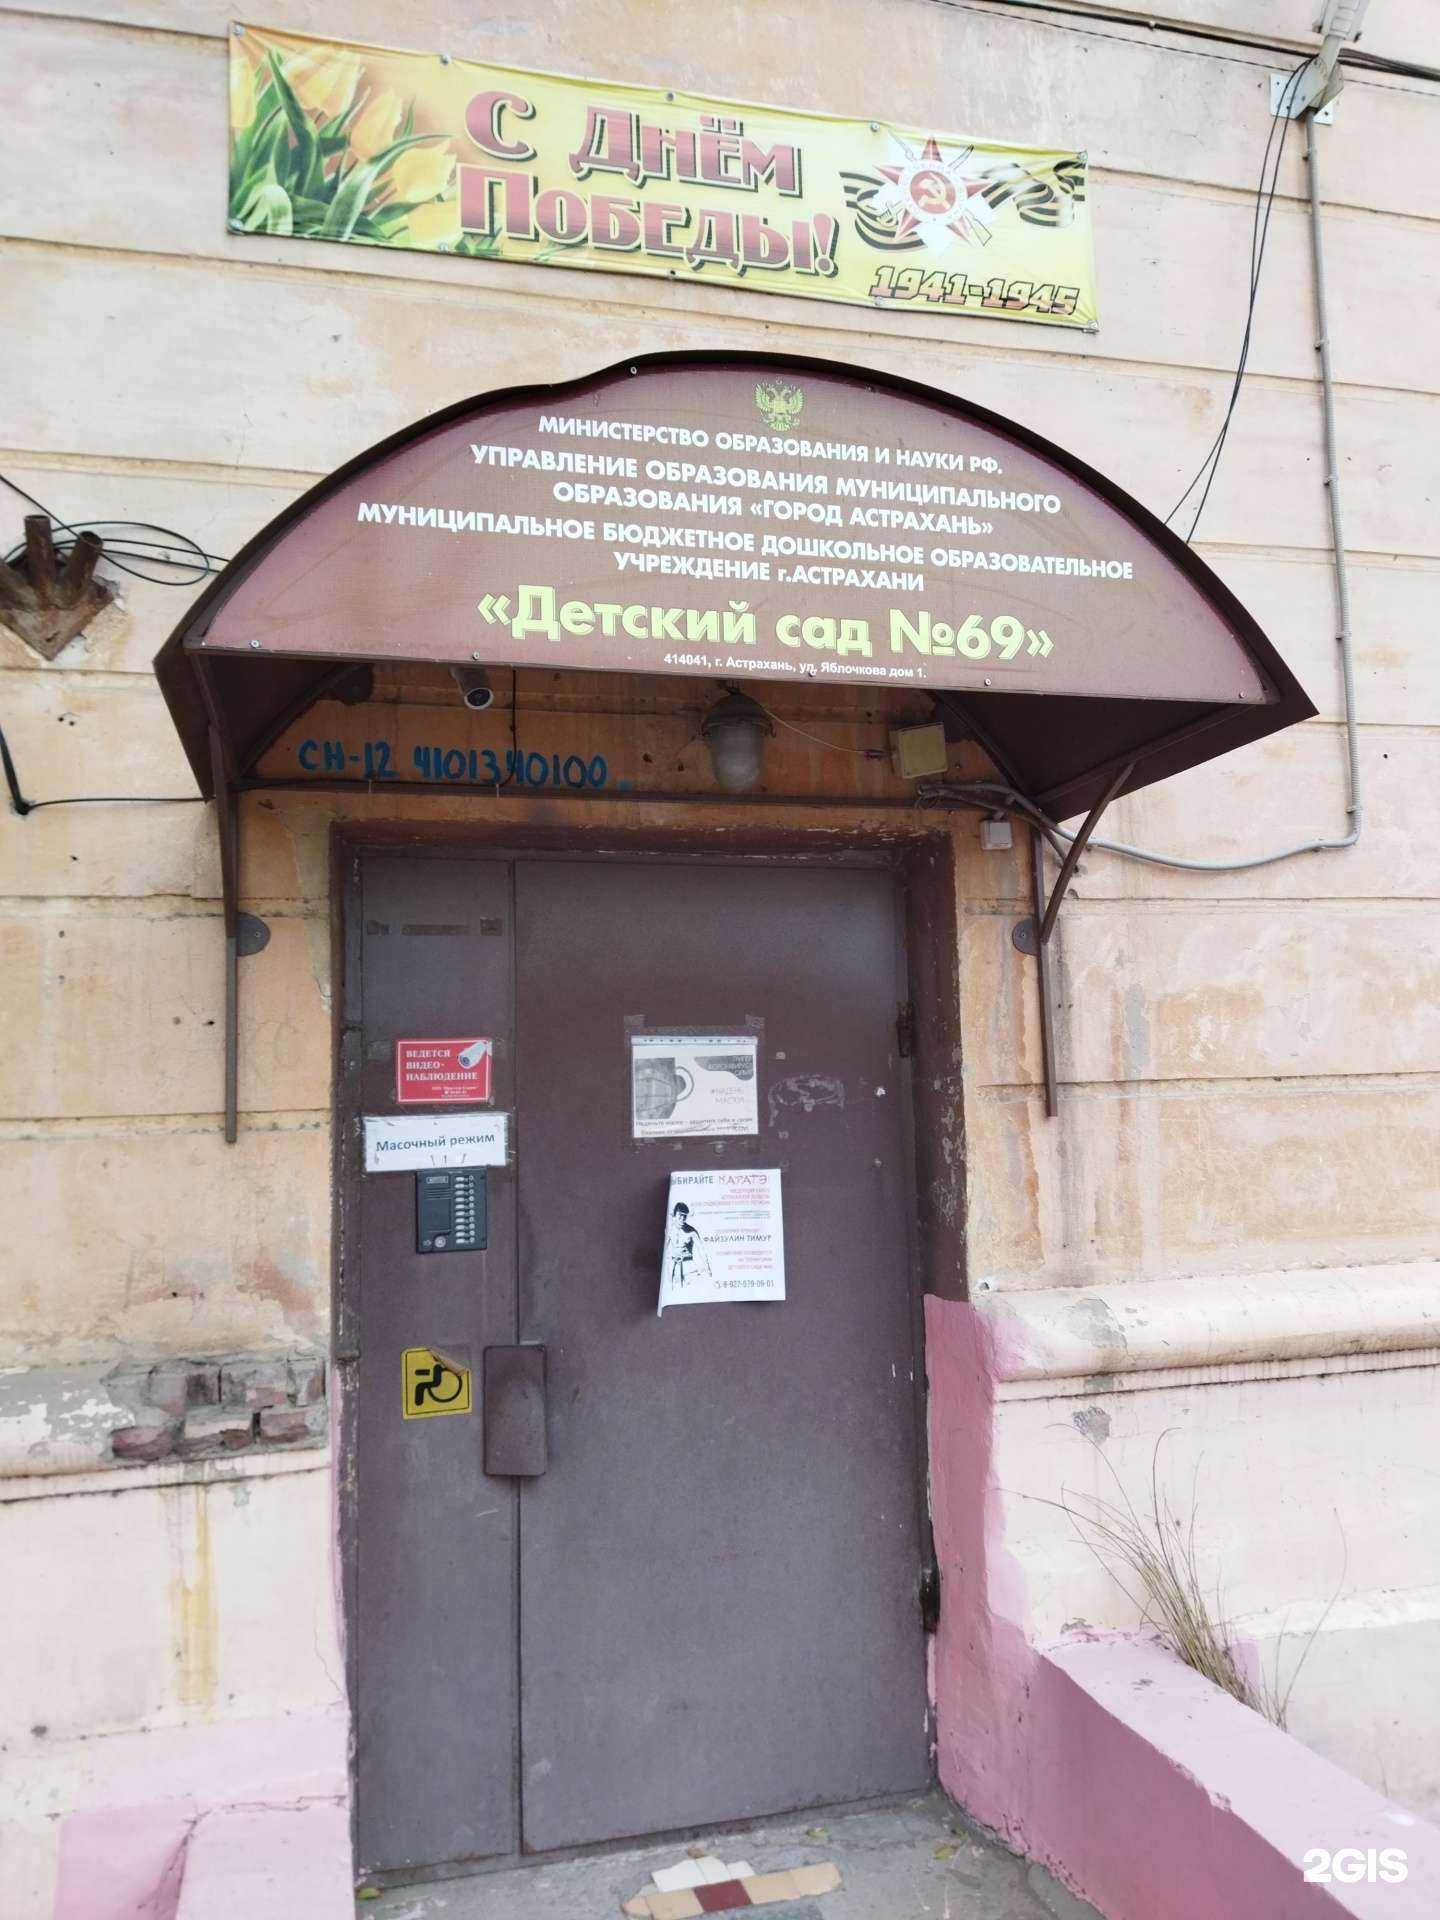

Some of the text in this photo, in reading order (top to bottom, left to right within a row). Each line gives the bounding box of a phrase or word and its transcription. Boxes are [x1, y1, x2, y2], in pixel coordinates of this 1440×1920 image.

[464, 90, 537, 161] С
[869, 265, 1081, 316] 1941-1945
[538, 415, 1003, 475] МИНИСТЕРСТВО ОБРАЗОВАНИЯ И НАУКИ РФ.
[469, 444, 1062, 514] УПРАВЛЕНИЕ ОБРАЗОВАНИЯ МУНИЦИПАЛЬНОГО
[552, 481, 994, 536] ОБРАЗОВАНИЯ «ГОРОД АСТРАХАНЬ»
[356, 502, 1134, 580] МУНИЦИПАЛЬНОЕ БЮДЖЕТНОЕ ДОШКОЛЬНОЕ ОБРАЗОВАТЕЛЬНОЕ
[613, 551, 925, 592] УЧРЕЖДЕНИЕ г.АСТРАХАНИ
[476, 583, 1055, 660] «Детский сад №69»
[664, 653, 712, 668] 414041,
[714, 657, 723, 667] г.
[726, 656, 796, 673] Астрахань,
[820, 663, 887, 677] Яблочкова
[889, 667, 914, 678] дом
[916, 667, 927, 679] 1.
[405, 1049, 451, 1058] ВЕДЕТСЯ
[405, 1061, 445, 1069] ВИДЕО-
[405, 1072, 478, 1081] НАБЛЮДЕНИЕ
[376, 1133, 495, 1152] Масочный режим
[718, 1173, 768, 1185] КАРАТЭ
